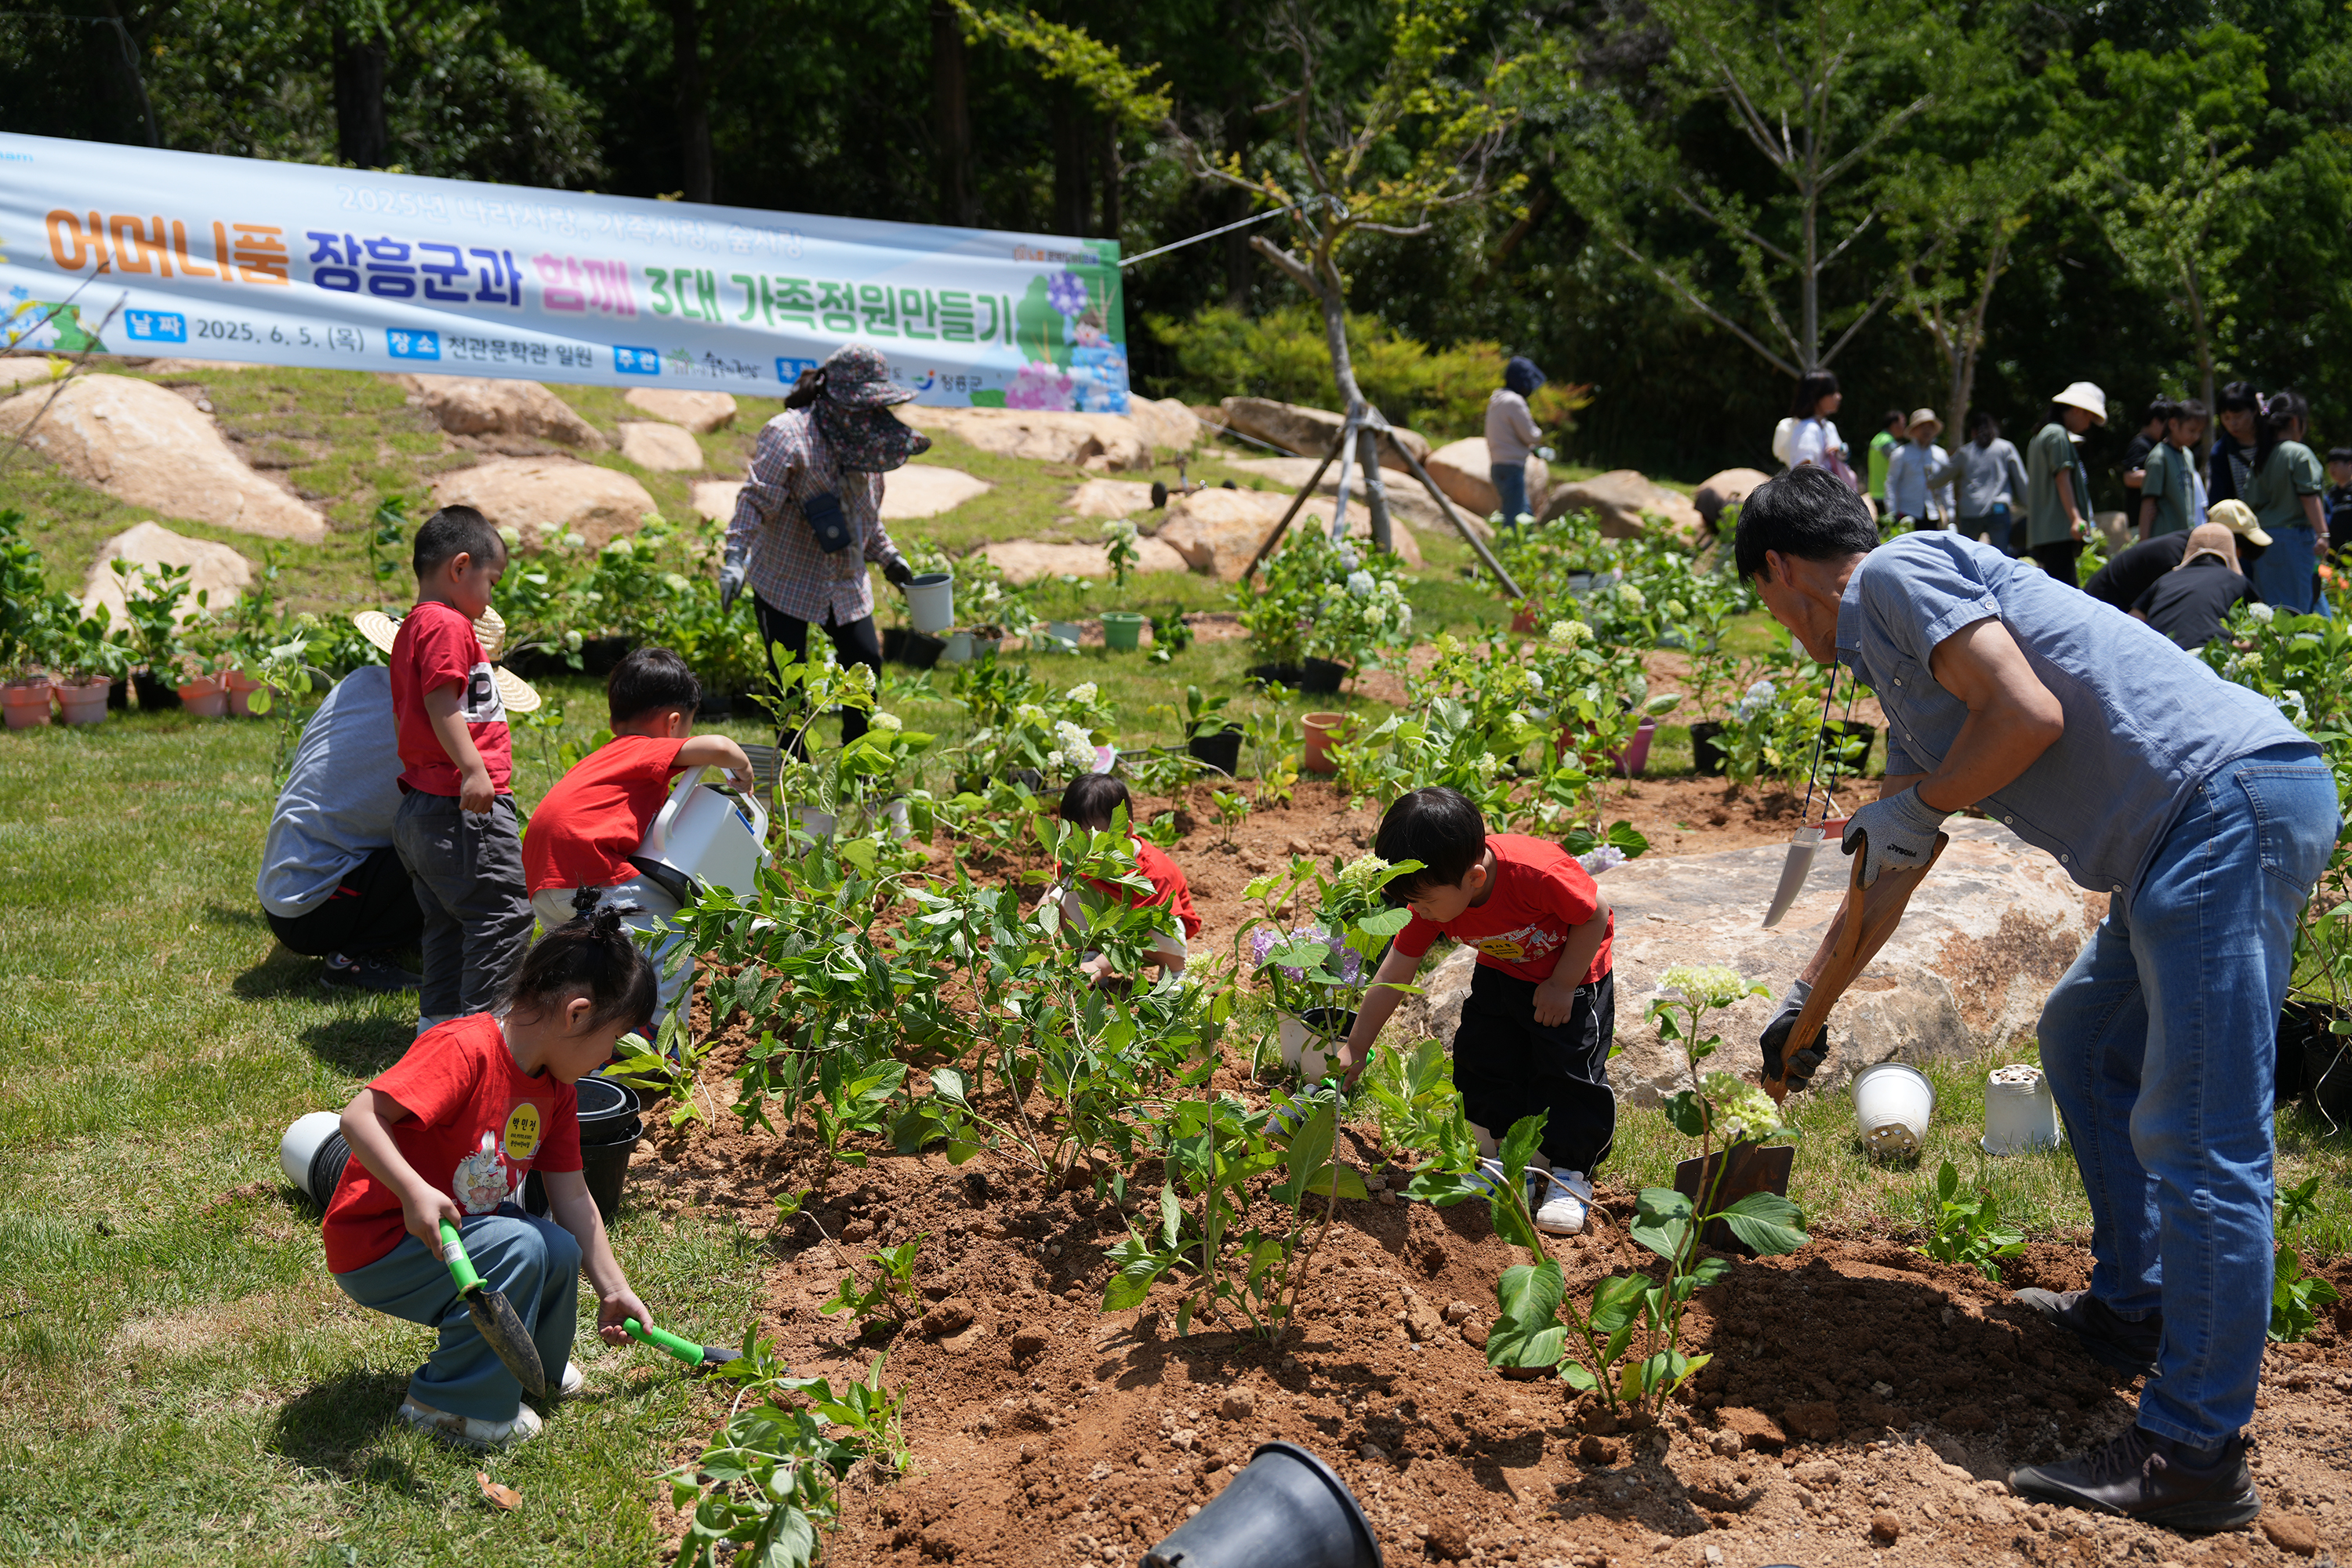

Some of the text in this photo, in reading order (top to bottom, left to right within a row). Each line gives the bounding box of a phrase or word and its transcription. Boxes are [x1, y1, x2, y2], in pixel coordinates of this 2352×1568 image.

[337, 183, 804, 259] 2025년 나라사랑, 가족사랑, 숲사랑
[45, 209, 1011, 345] 어머니품 장흥군과 함께 3대 가족정원만들기
[198, 318, 262, 345] 2025.
[270, 322, 289, 347] 6.
[299, 325, 318, 348] 5.
[328, 326, 365, 353] (목)
[448, 336, 550, 366] 천관문학관
[555, 345, 593, 368] 일원
[940, 374, 983, 393] 장흥군
